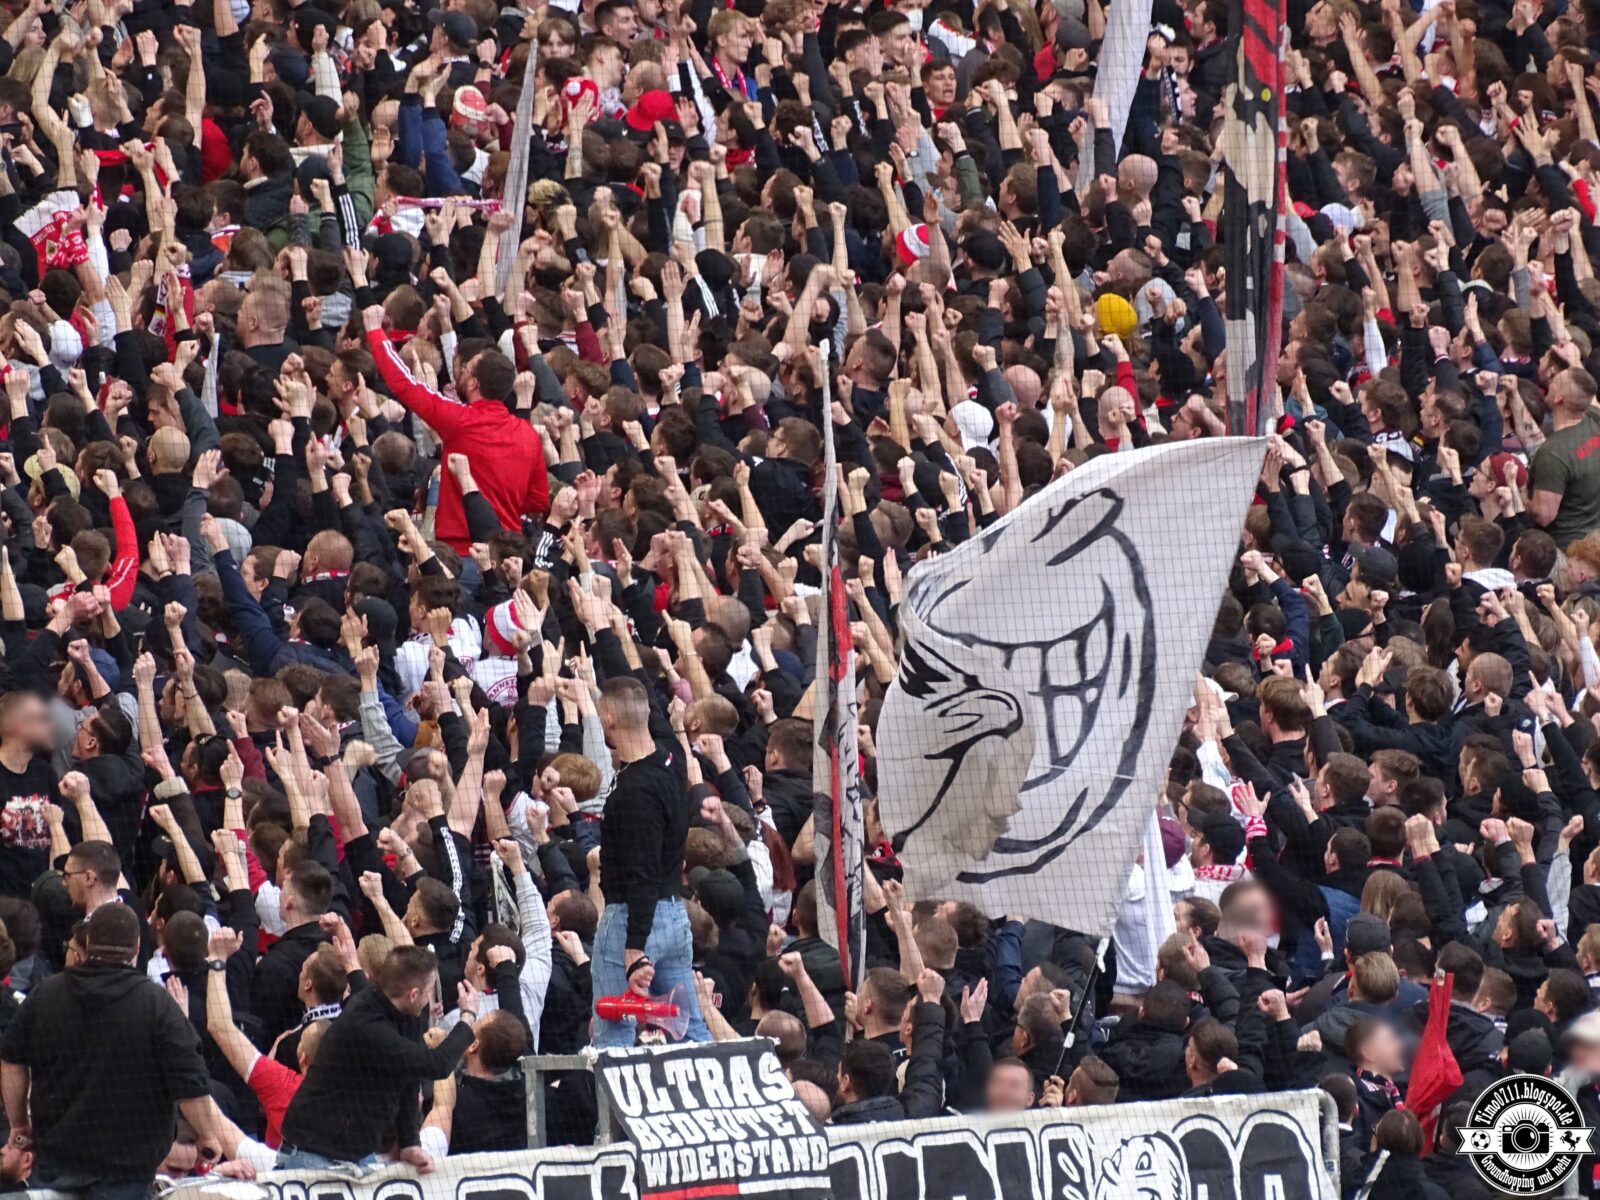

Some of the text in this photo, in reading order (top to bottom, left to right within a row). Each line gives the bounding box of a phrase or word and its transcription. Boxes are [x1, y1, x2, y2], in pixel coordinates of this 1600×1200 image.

[488, 679, 516, 700] ANNST
[603, 1051, 795, 1118] ULTRAS
[624, 1100, 816, 1150] BEDEUTET
[640, 1135, 829, 1187] WIDERSTAND
